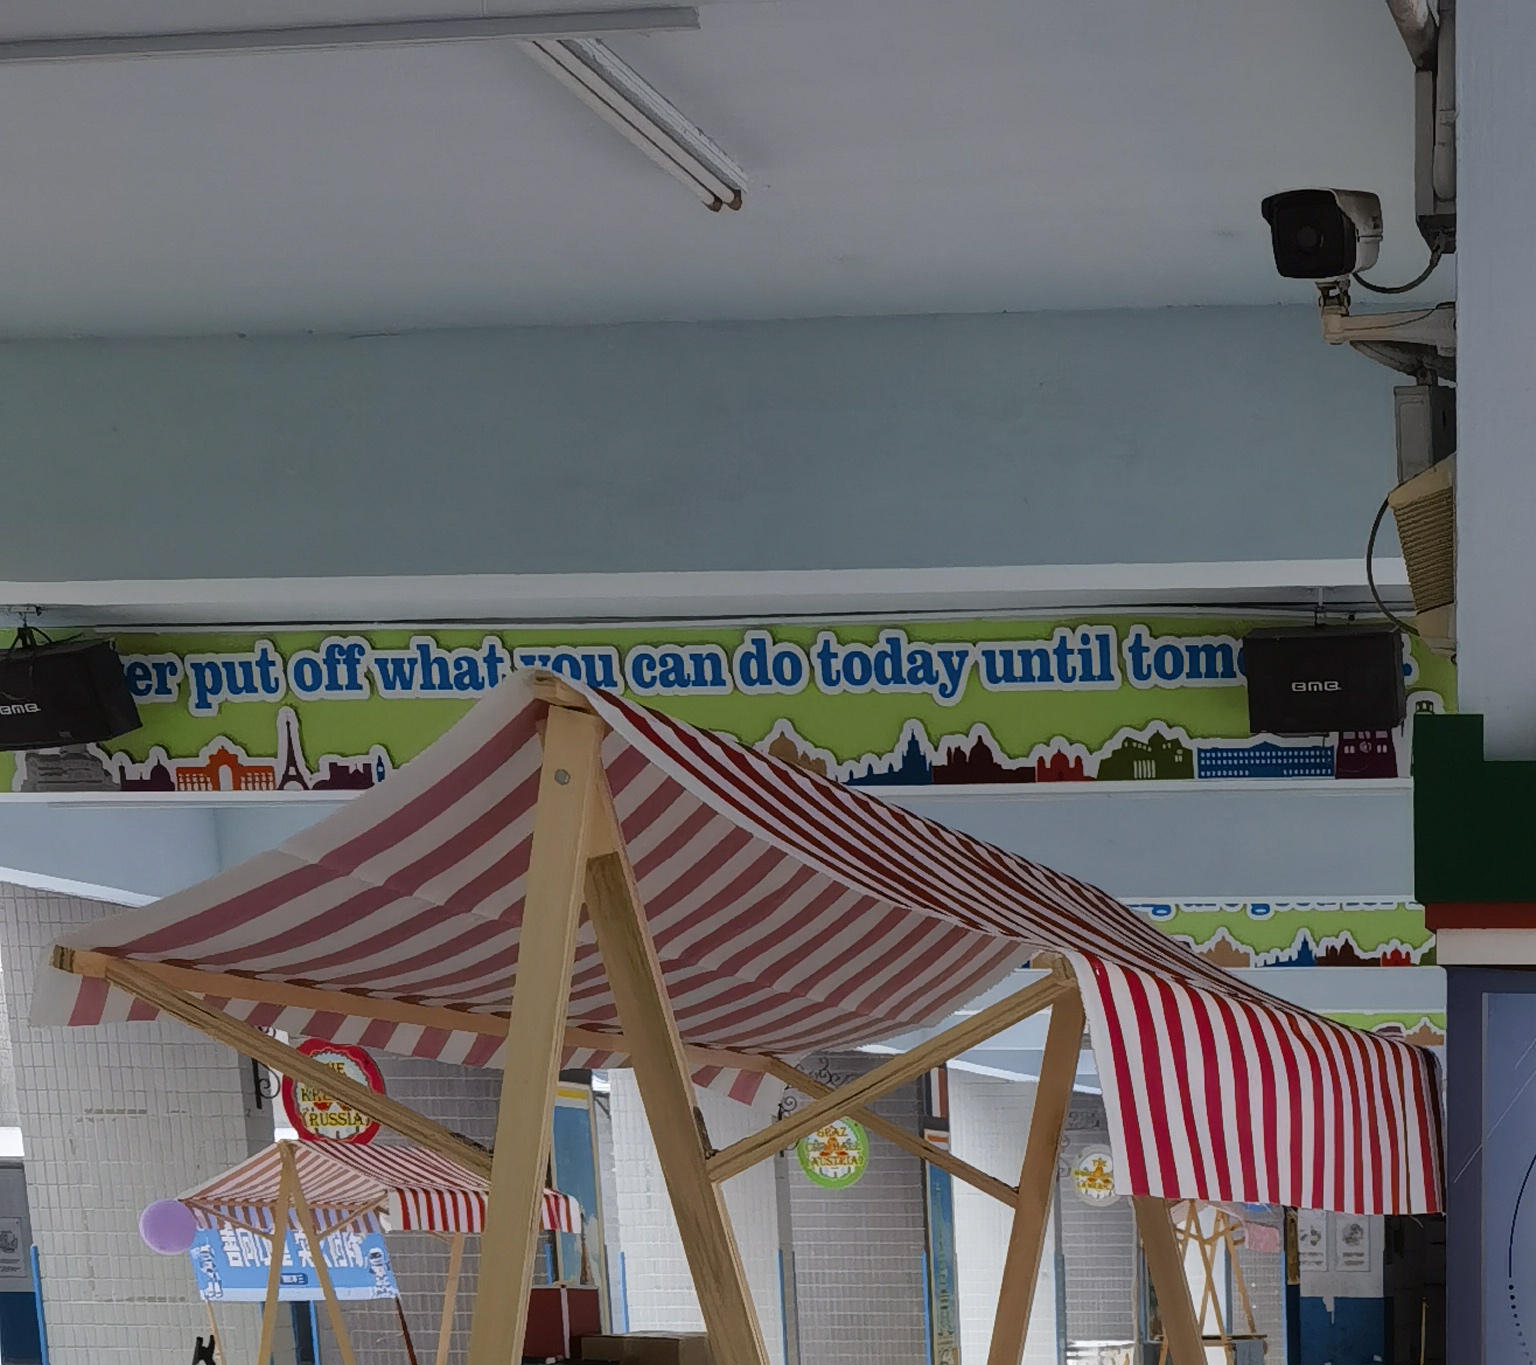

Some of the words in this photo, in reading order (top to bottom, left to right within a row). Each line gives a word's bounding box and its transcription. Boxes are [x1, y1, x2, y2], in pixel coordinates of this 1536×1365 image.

[122, 660, 178, 696] er
[196, 646, 279, 708] put
[296, 644, 364, 694] off
[378, 643, 504, 692] what
[632, 651, 726, 688] can
[740, 638, 801, 686] do
[818, 637, 969, 698] today
[984, 634, 1114, 683] until
[1128, 633, 1246, 681] tom
